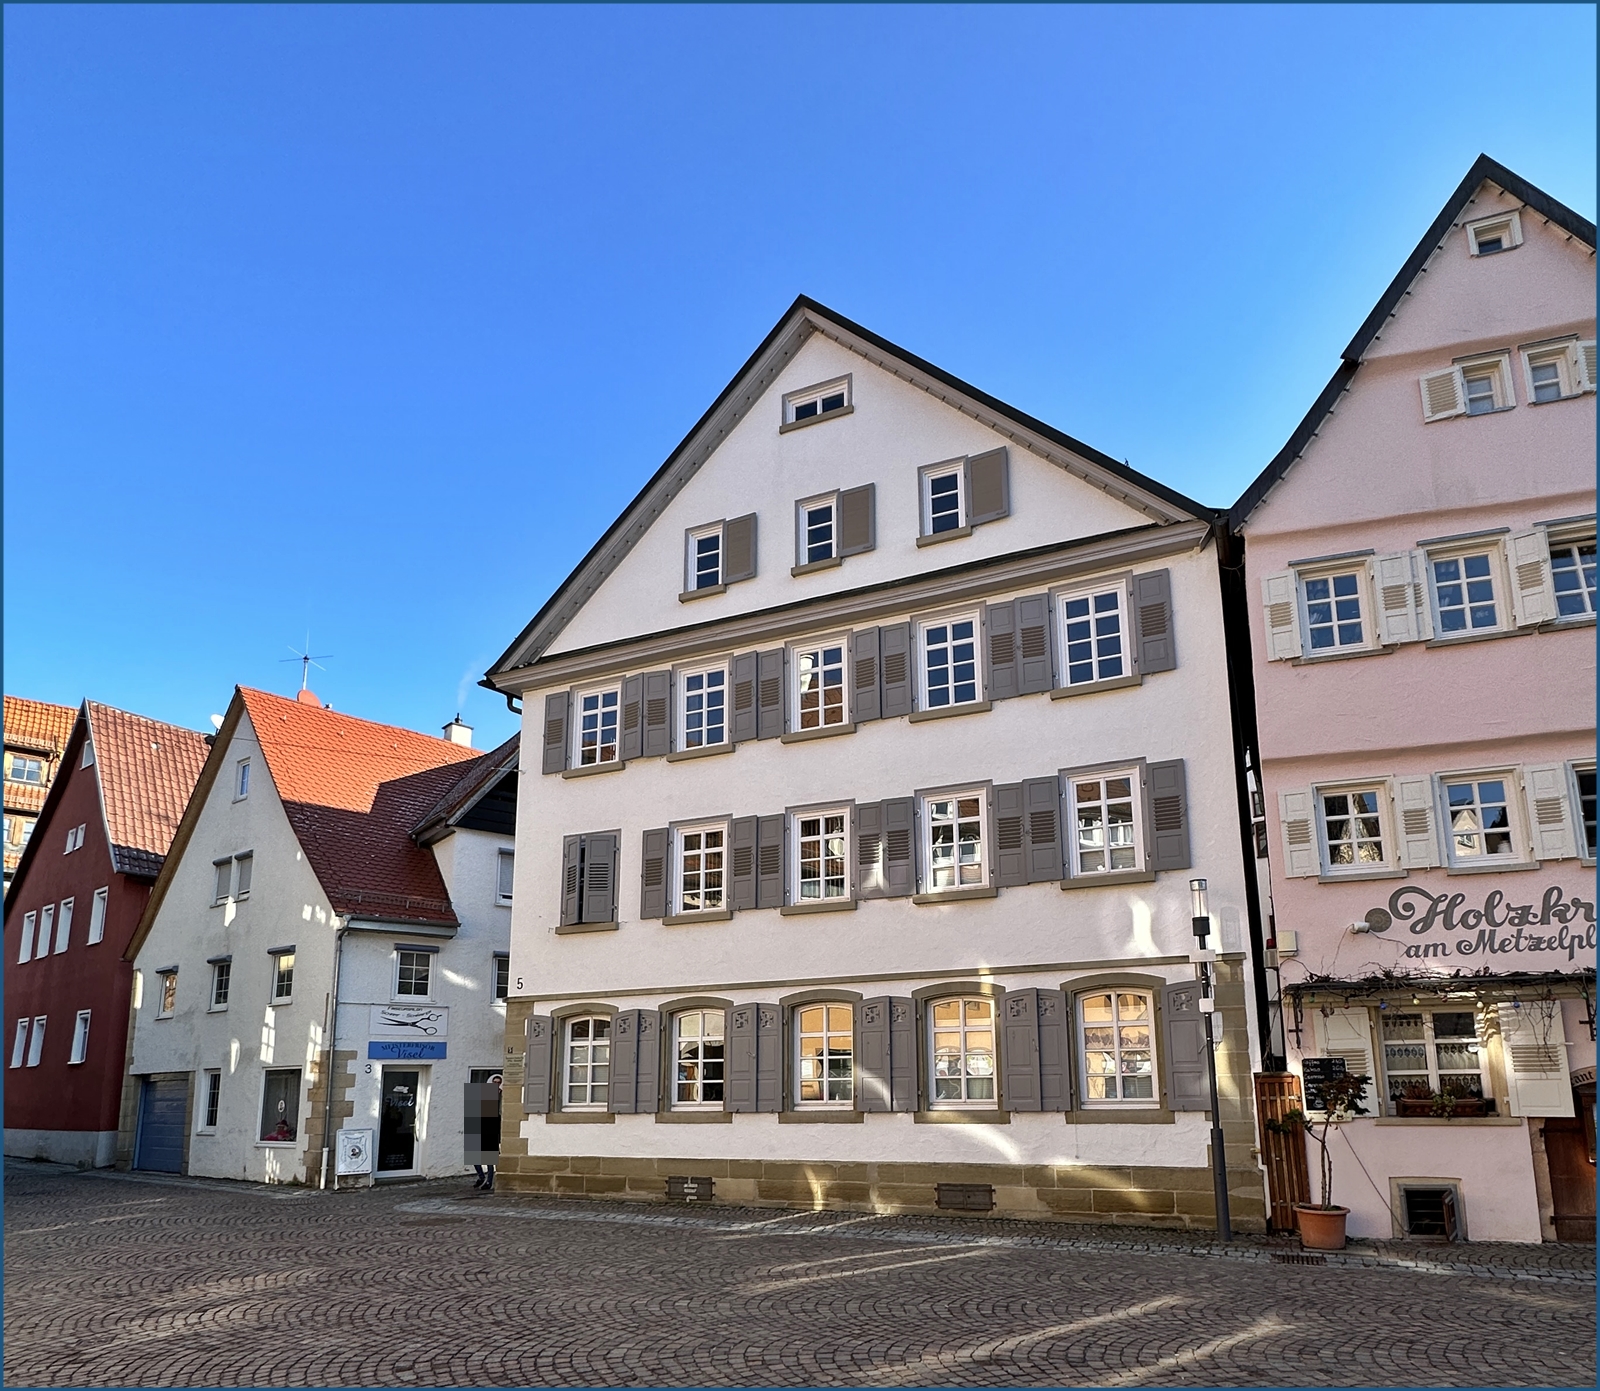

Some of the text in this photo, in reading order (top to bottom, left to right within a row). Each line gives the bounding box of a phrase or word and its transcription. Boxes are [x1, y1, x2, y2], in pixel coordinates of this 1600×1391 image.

[1404, 942, 1452, 959] am
[516, 977, 524, 990] 5
[390, 1047, 425, 1059] Visel
[364, 1063, 372, 1074] 3
